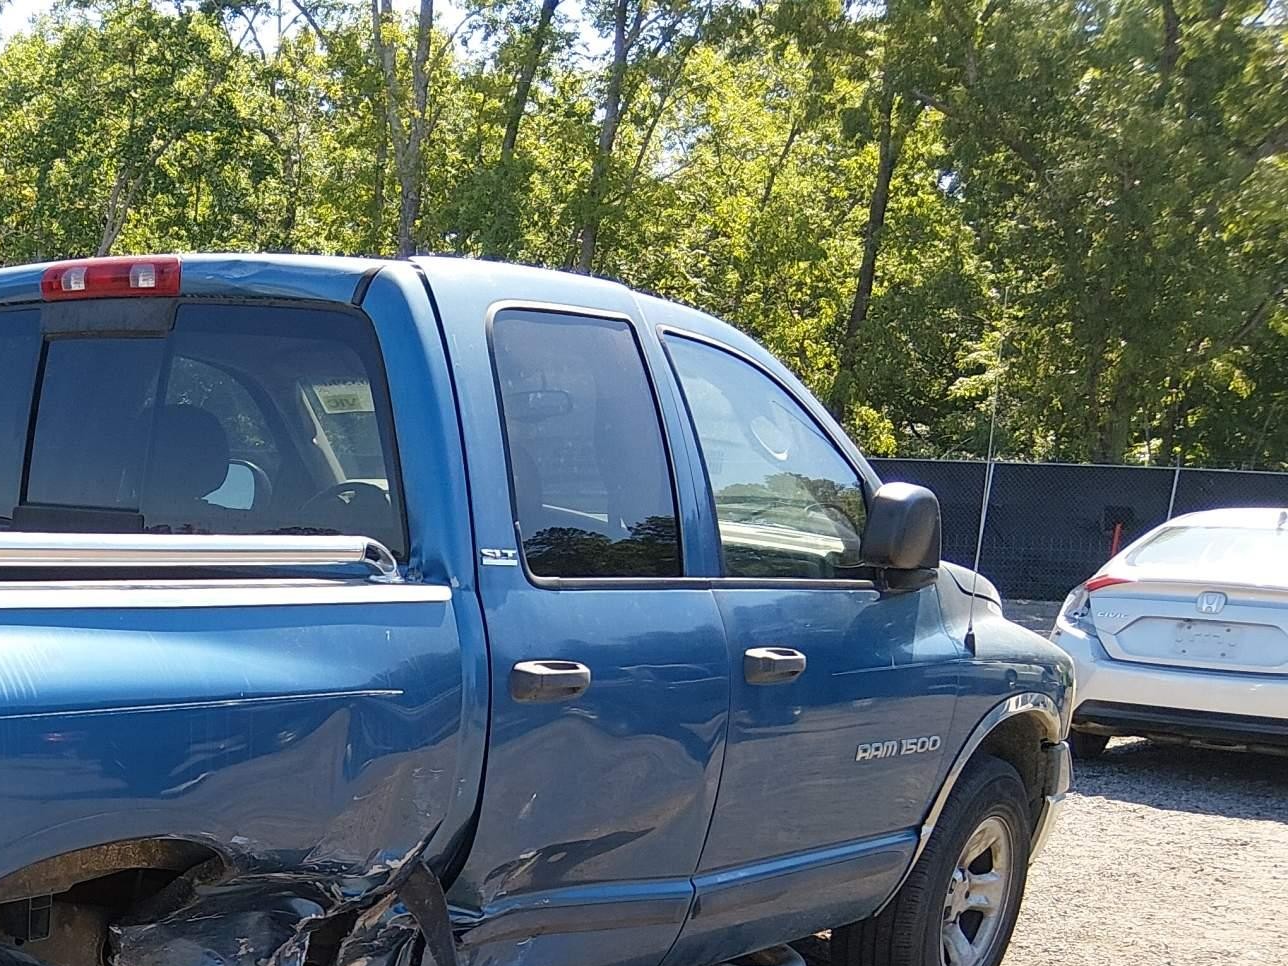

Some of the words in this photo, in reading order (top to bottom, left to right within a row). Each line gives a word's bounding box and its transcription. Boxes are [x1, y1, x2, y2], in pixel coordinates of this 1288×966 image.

[480, 548, 517, 559] SLT
[855, 740, 897, 761] RAM
[900, 736, 941, 755] 1500
